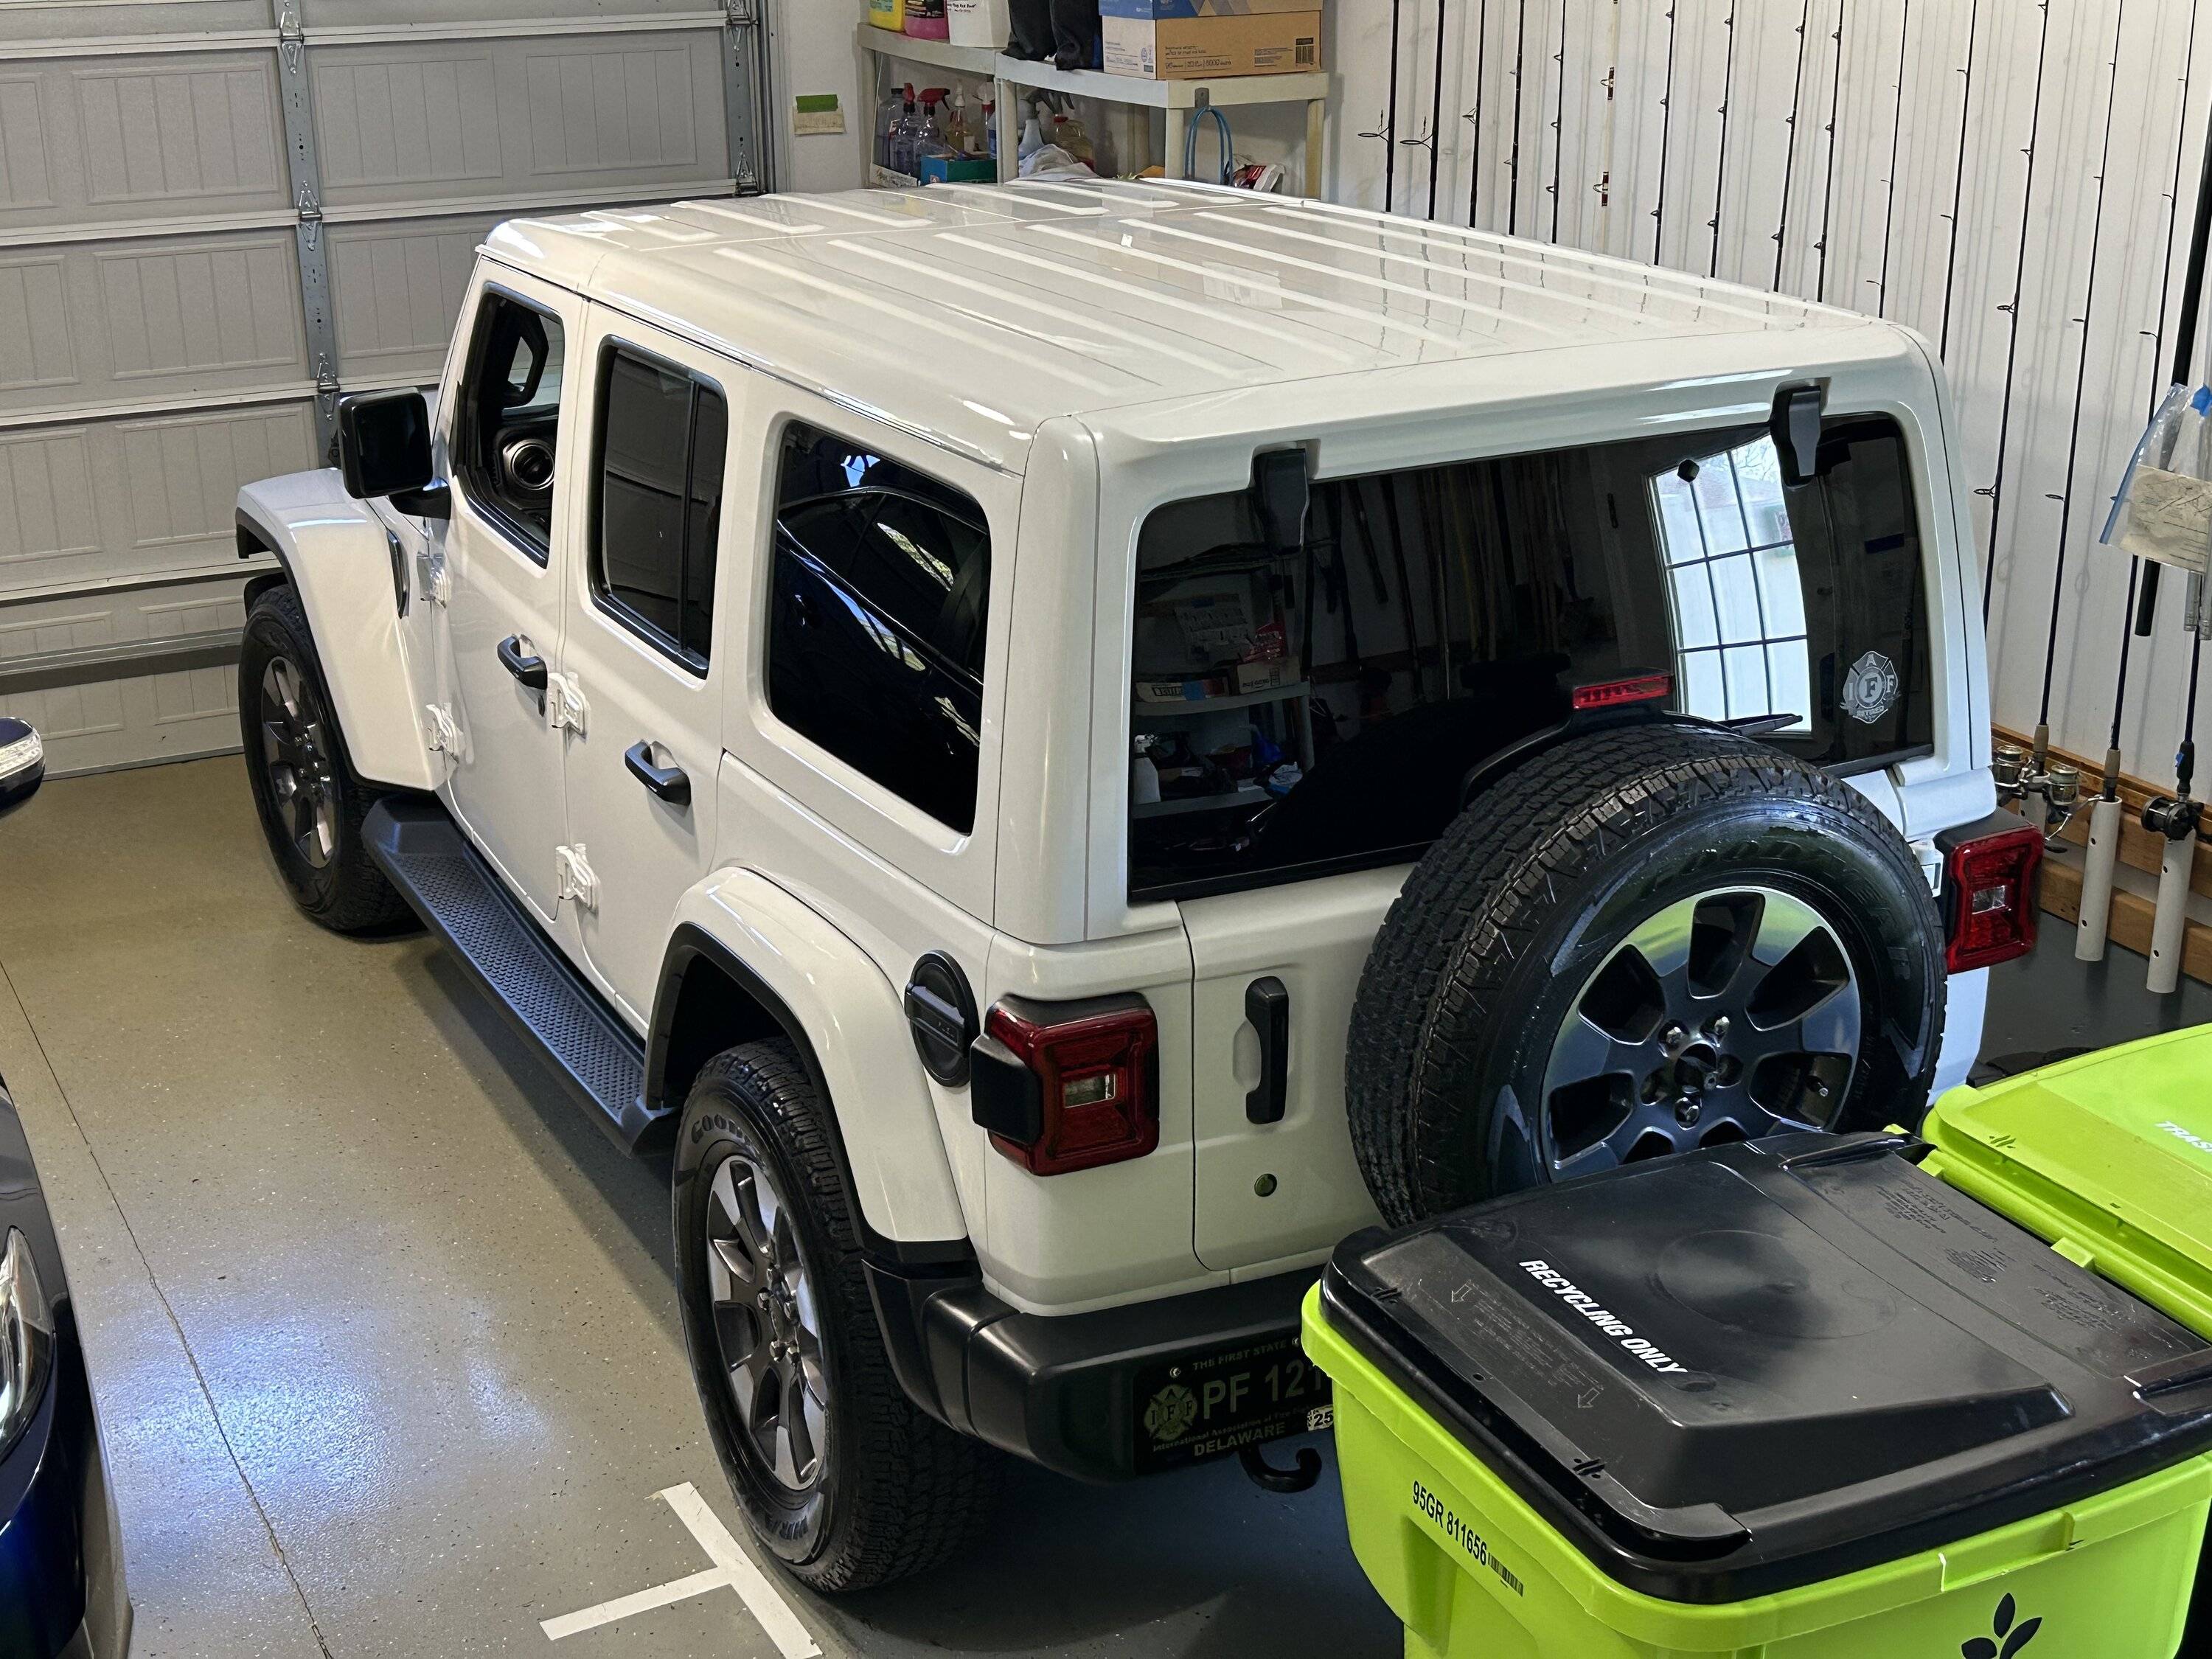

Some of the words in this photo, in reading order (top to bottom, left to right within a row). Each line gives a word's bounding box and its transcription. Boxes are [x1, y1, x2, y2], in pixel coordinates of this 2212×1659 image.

[1518, 1259, 1633, 1338] RECYCLING
[1620, 1338, 1689, 1374] ONLY
[1192, 1358, 1216, 1371] THE
[1218, 1349, 1251, 1366] FIRST
[1253, 1340, 1287, 1356] STATE
[1203, 1371, 1251, 1420] PF
[1194, 1421, 1287, 1457] DELAWARE
[1313, 1410, 1334, 1427] 25
[1412, 1479, 1444, 1528] 95GR
[1446, 1511, 1487, 1566] 811656
